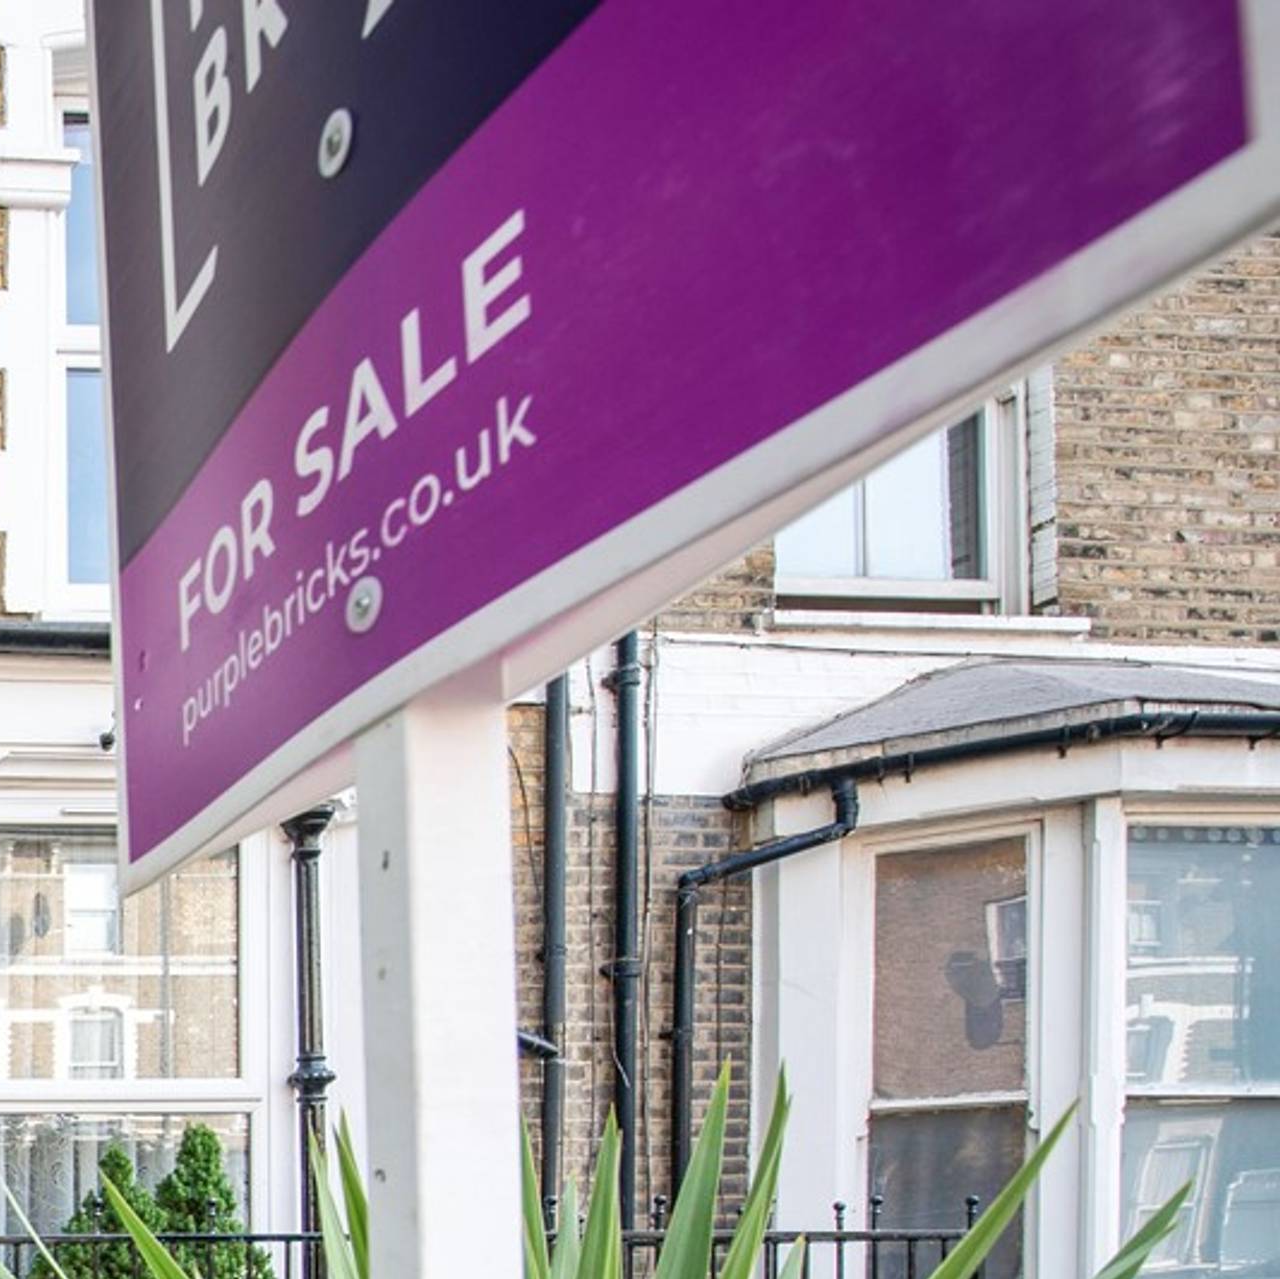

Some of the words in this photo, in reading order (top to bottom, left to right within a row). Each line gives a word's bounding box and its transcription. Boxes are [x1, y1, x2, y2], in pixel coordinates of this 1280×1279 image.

[178, 479, 275, 652] FOR
[293, 209, 532, 517] SALE
[182, 394, 537, 746] purplebricks.co.uk
